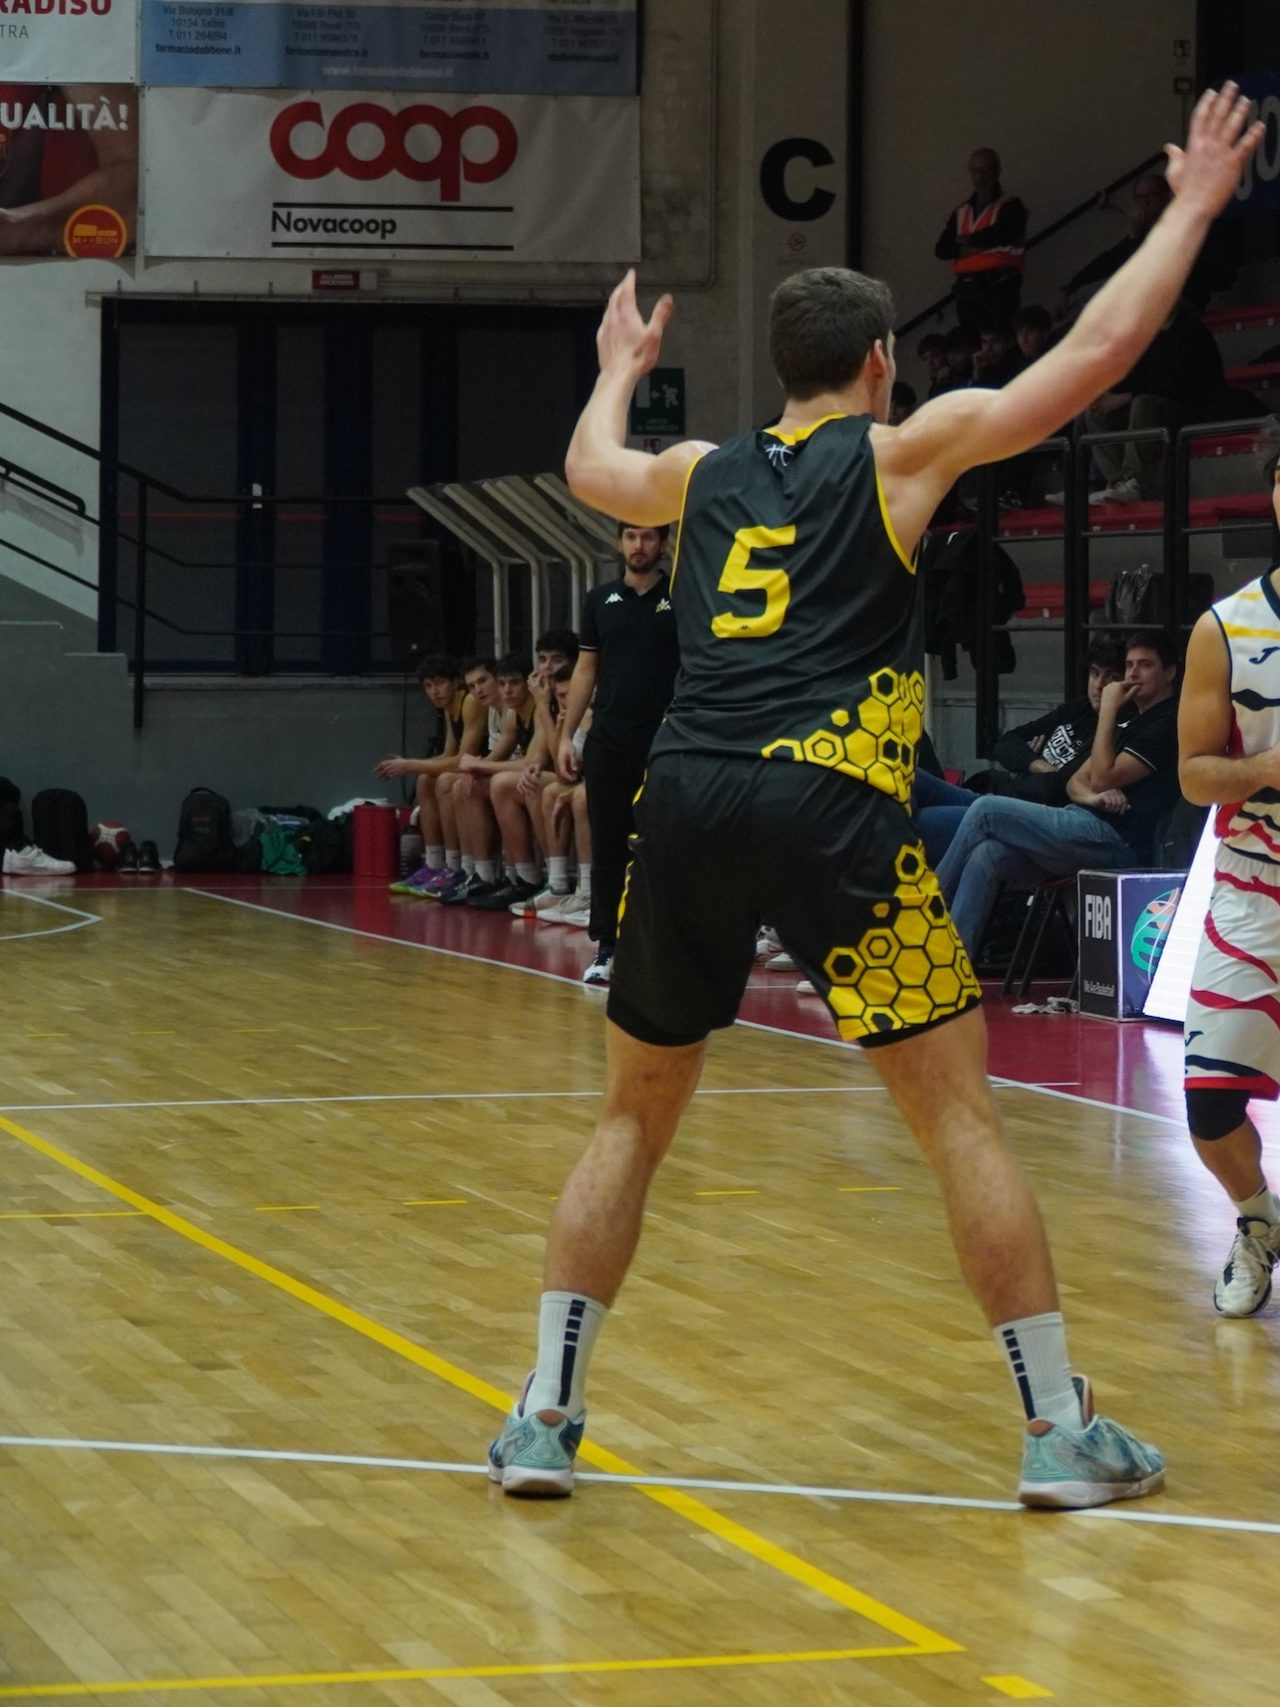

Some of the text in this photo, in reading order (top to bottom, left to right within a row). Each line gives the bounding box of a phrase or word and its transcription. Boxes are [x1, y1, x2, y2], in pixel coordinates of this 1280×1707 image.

[269, 101, 518, 202] coop
[759, 137, 837, 223] C
[271, 210, 398, 240] Novacoop
[710, 523, 798, 639] 5
[1085, 894, 1112, 941] FIBA
